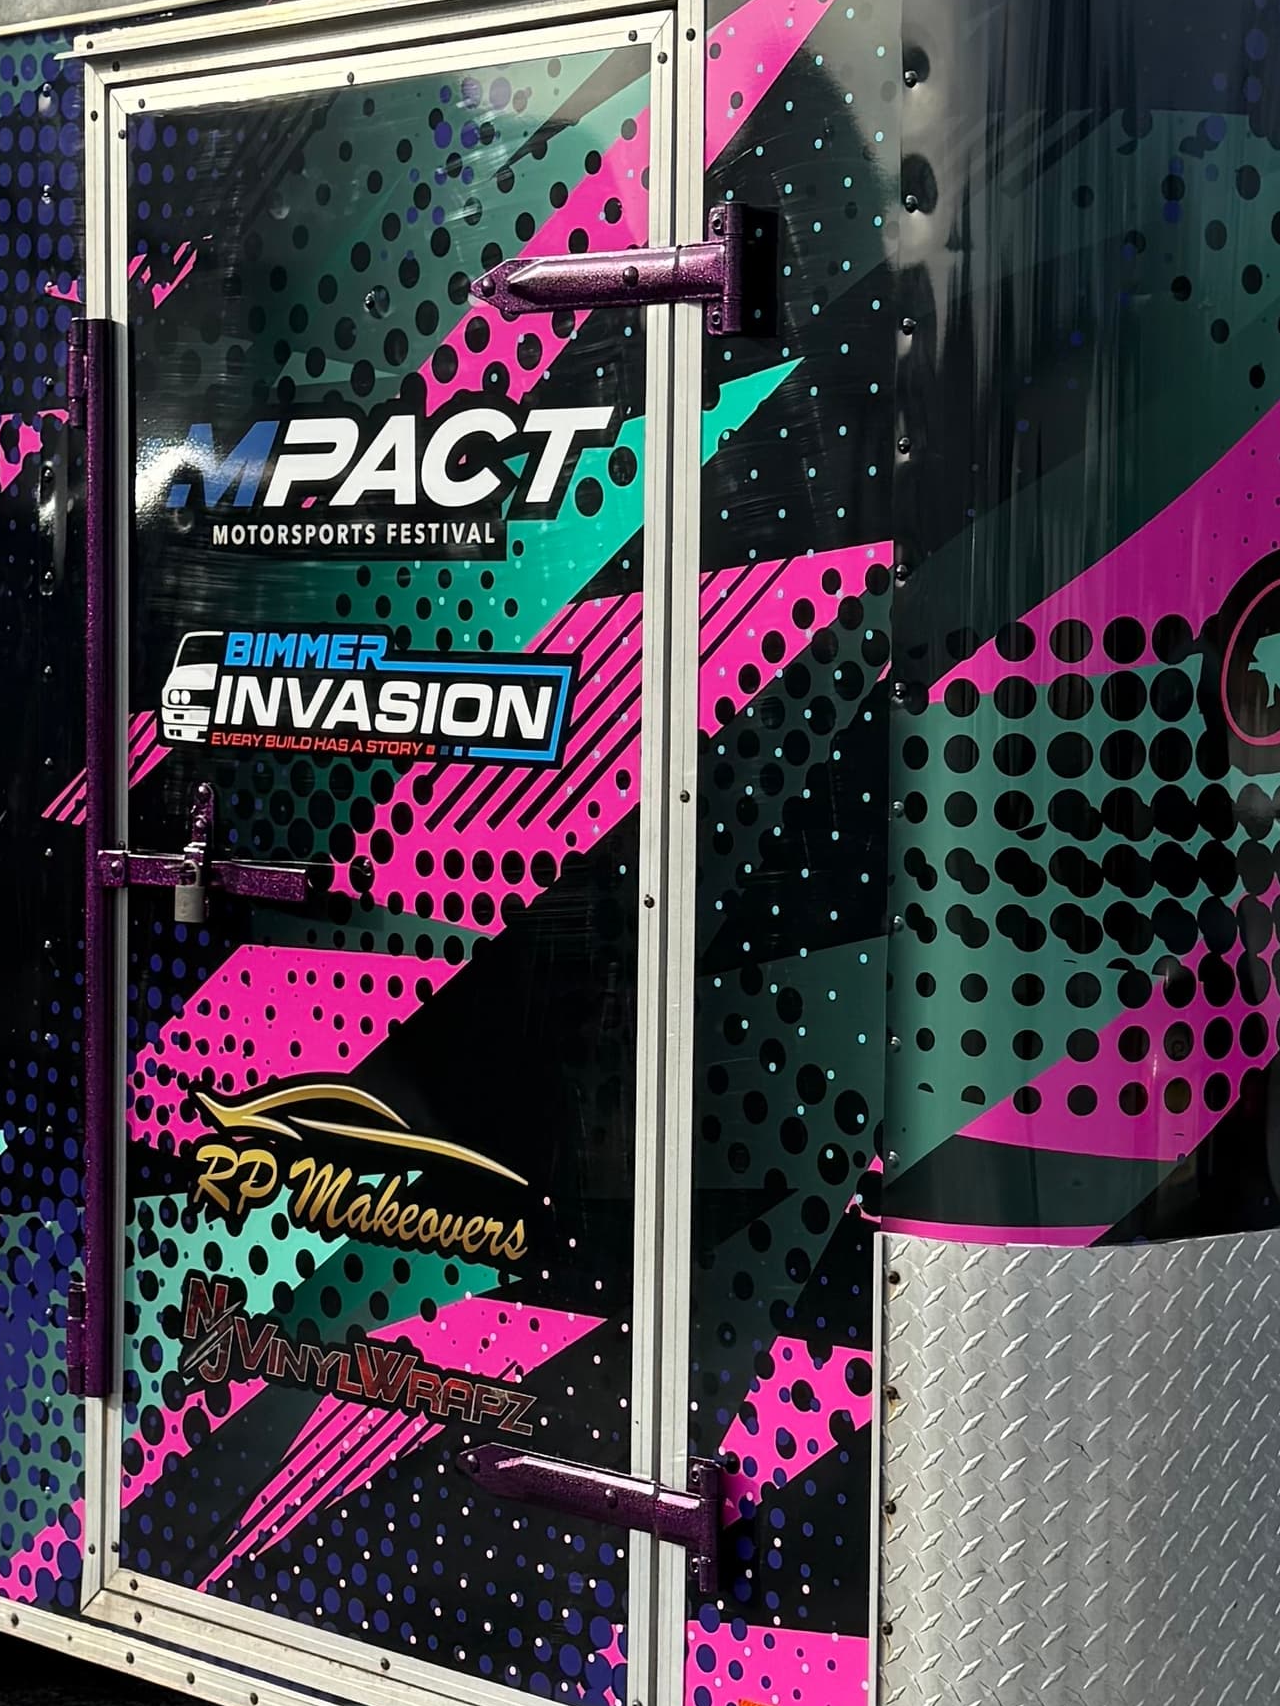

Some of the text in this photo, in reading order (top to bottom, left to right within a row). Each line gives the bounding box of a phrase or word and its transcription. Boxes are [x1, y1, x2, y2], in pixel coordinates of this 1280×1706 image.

[166, 406, 615, 508] MPACT
[213, 523, 495, 545] MOTORSPORTS FESTIVAL
[224, 632, 388, 670] BIMMER
[215, 674, 553, 740] INVASION
[211, 732, 423, 755] EVERY BUILD HAS A STORY
[192, 1144, 528, 1261] RP Makeovers
